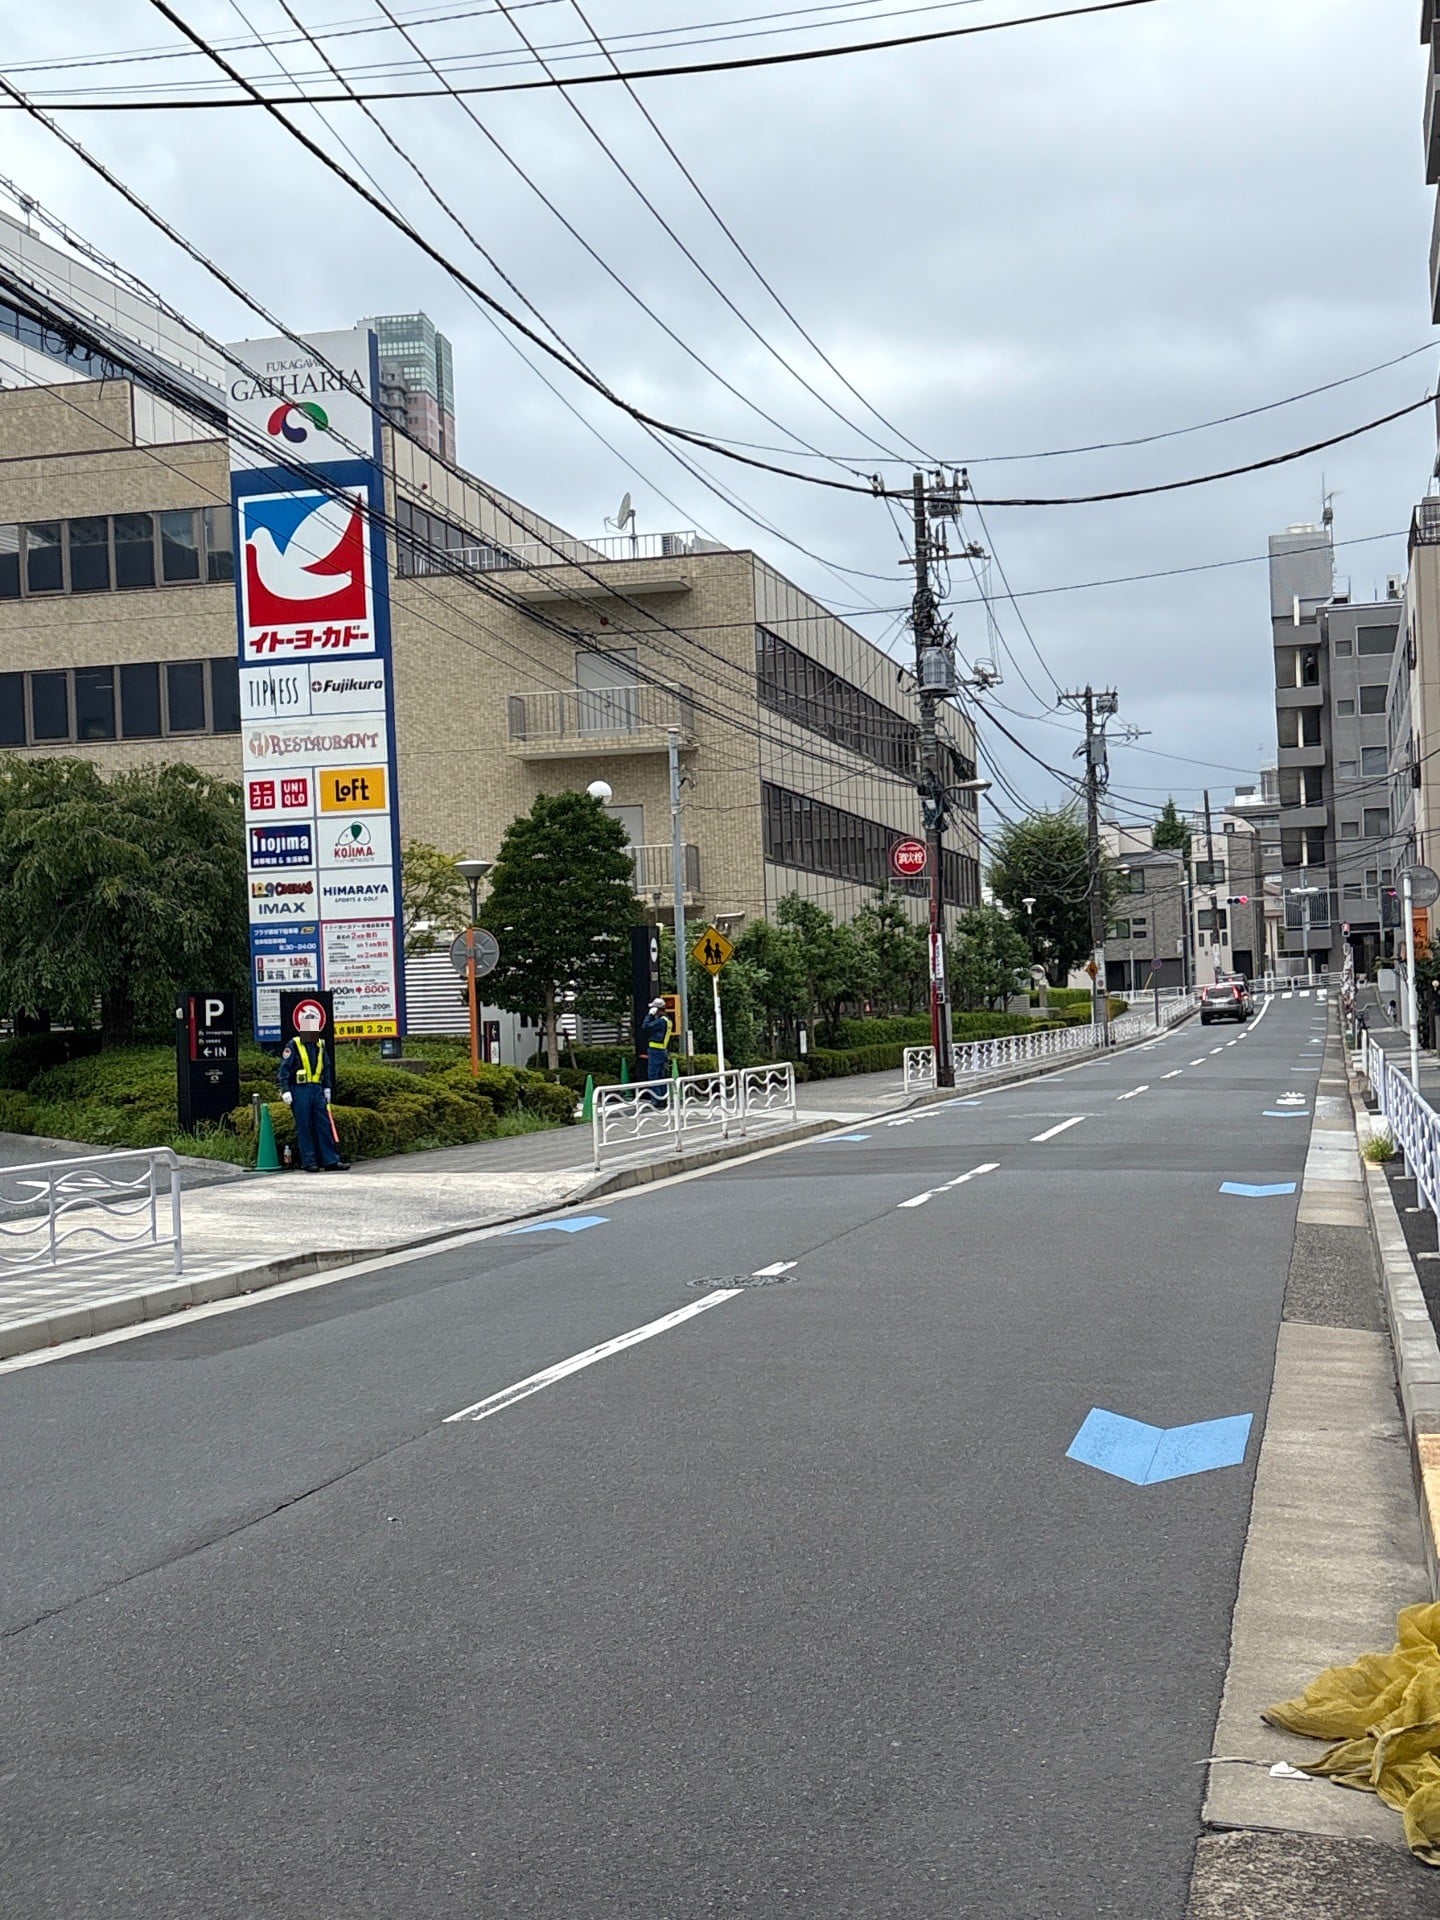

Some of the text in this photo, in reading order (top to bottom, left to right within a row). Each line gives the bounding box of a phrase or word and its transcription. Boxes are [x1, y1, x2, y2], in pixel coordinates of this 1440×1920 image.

[230, 368, 366, 402] GATHARIA
[249, 625, 369, 654] イトーヨーカドー
[248, 668, 299, 715] TIPNESS
[323, 679, 384, 694] Fujikura
[268, 732, 379, 756] RESTAURANT
[284, 782, 303, 793] UNI
[284, 793, 305, 806] QLO
[898, 851, 924, 865] 消火栓
[323, 884, 389, 896] HIMARAYA
[258, 902, 306, 915] IMAX
[205, 999, 225, 1026] P
[214, 1046, 227, 1057] IN
